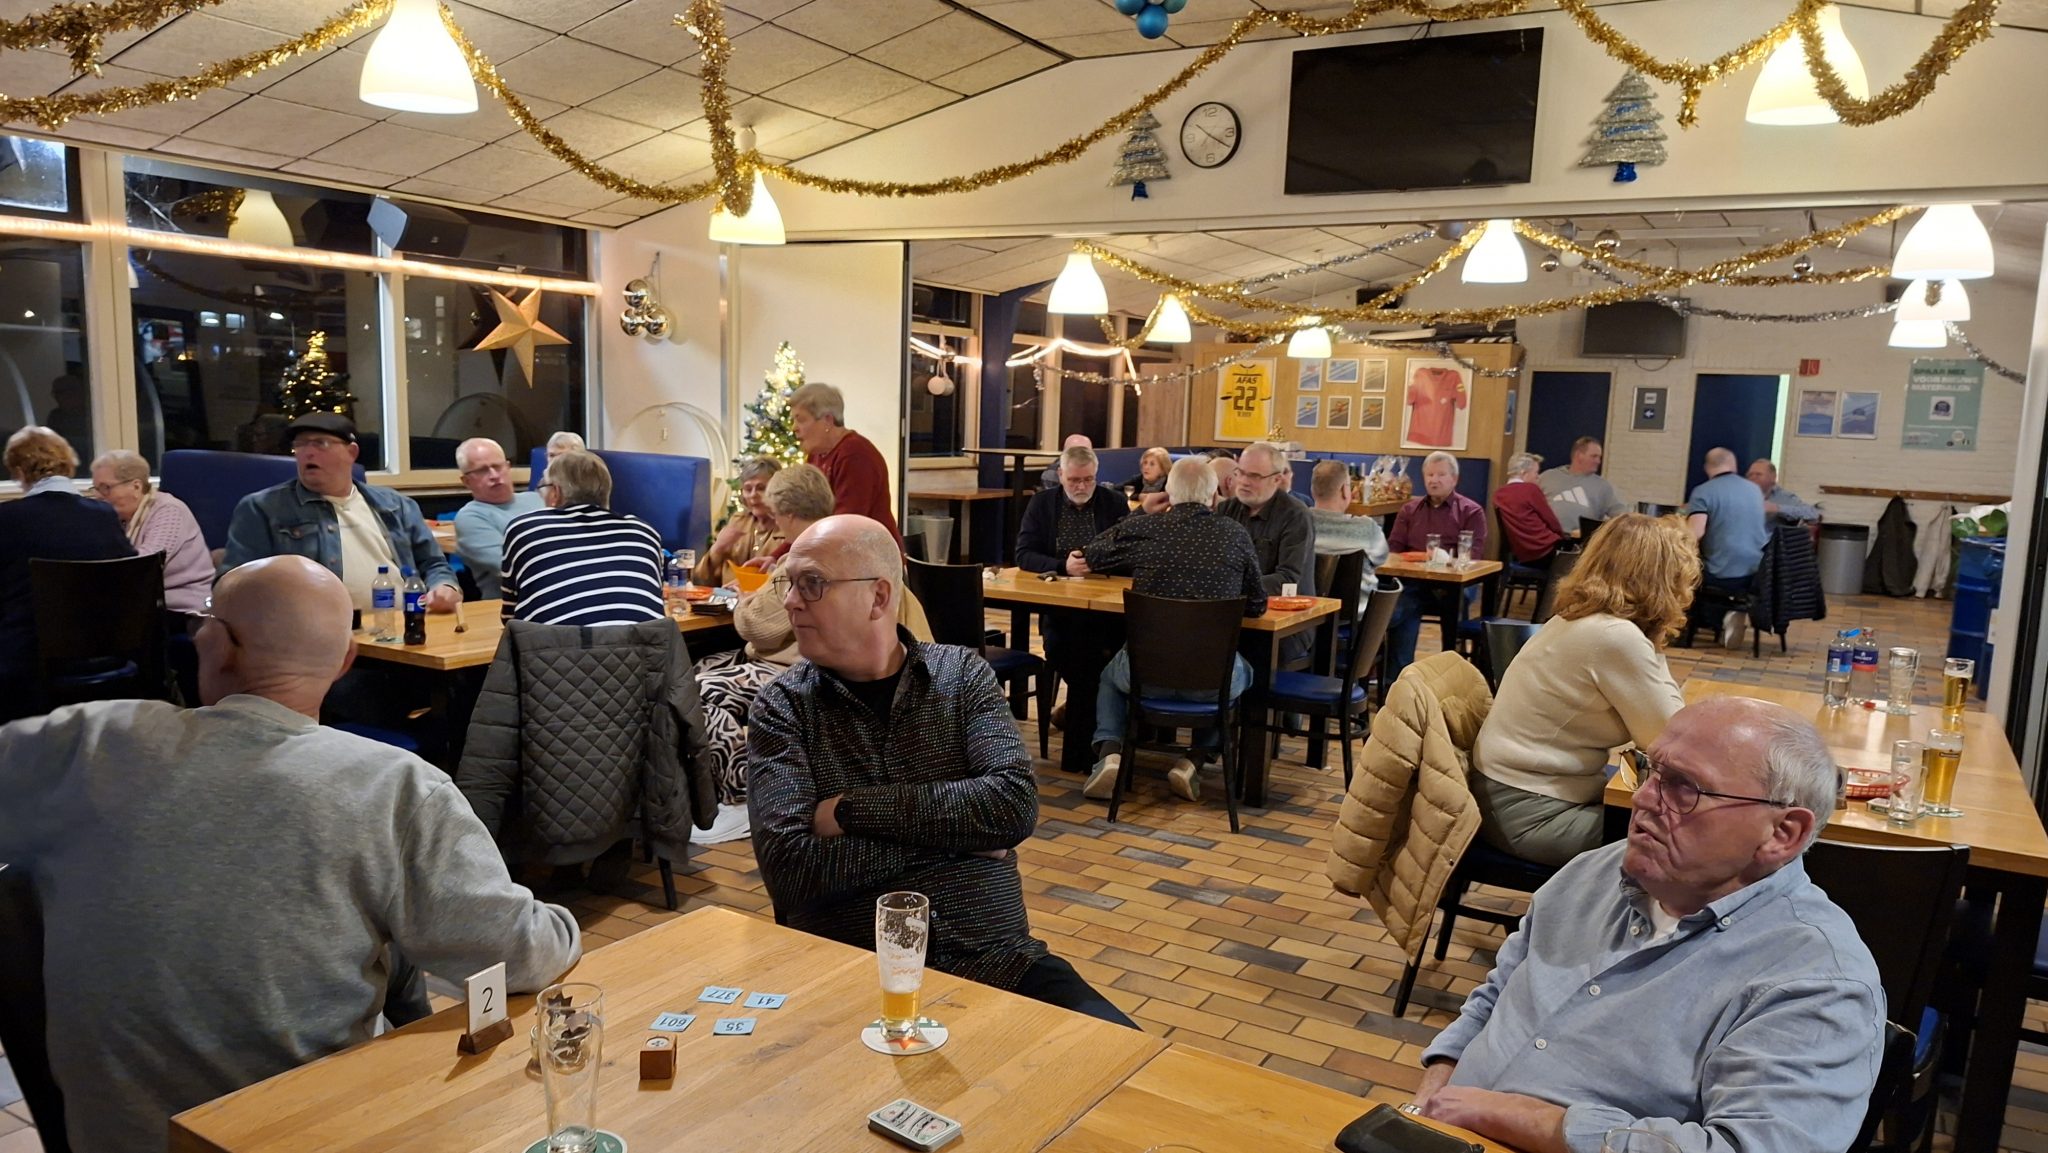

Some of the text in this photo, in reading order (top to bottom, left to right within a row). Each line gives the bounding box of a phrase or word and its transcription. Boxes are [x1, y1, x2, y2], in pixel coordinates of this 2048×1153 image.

[1203, 107, 1217, 117] 12
[1225, 127, 1235, 138] 3
[1186, 134, 1195, 143] 9
[1206, 153, 1215, 163] 6
[1233, 386, 1257, 411] 22
[482, 986, 493, 1014] 2
[707, 990, 735, 1000] 377
[758, 997, 775, 1006] 41
[659, 1017, 687, 1027] 601
[725, 1022, 744, 1031] 35
